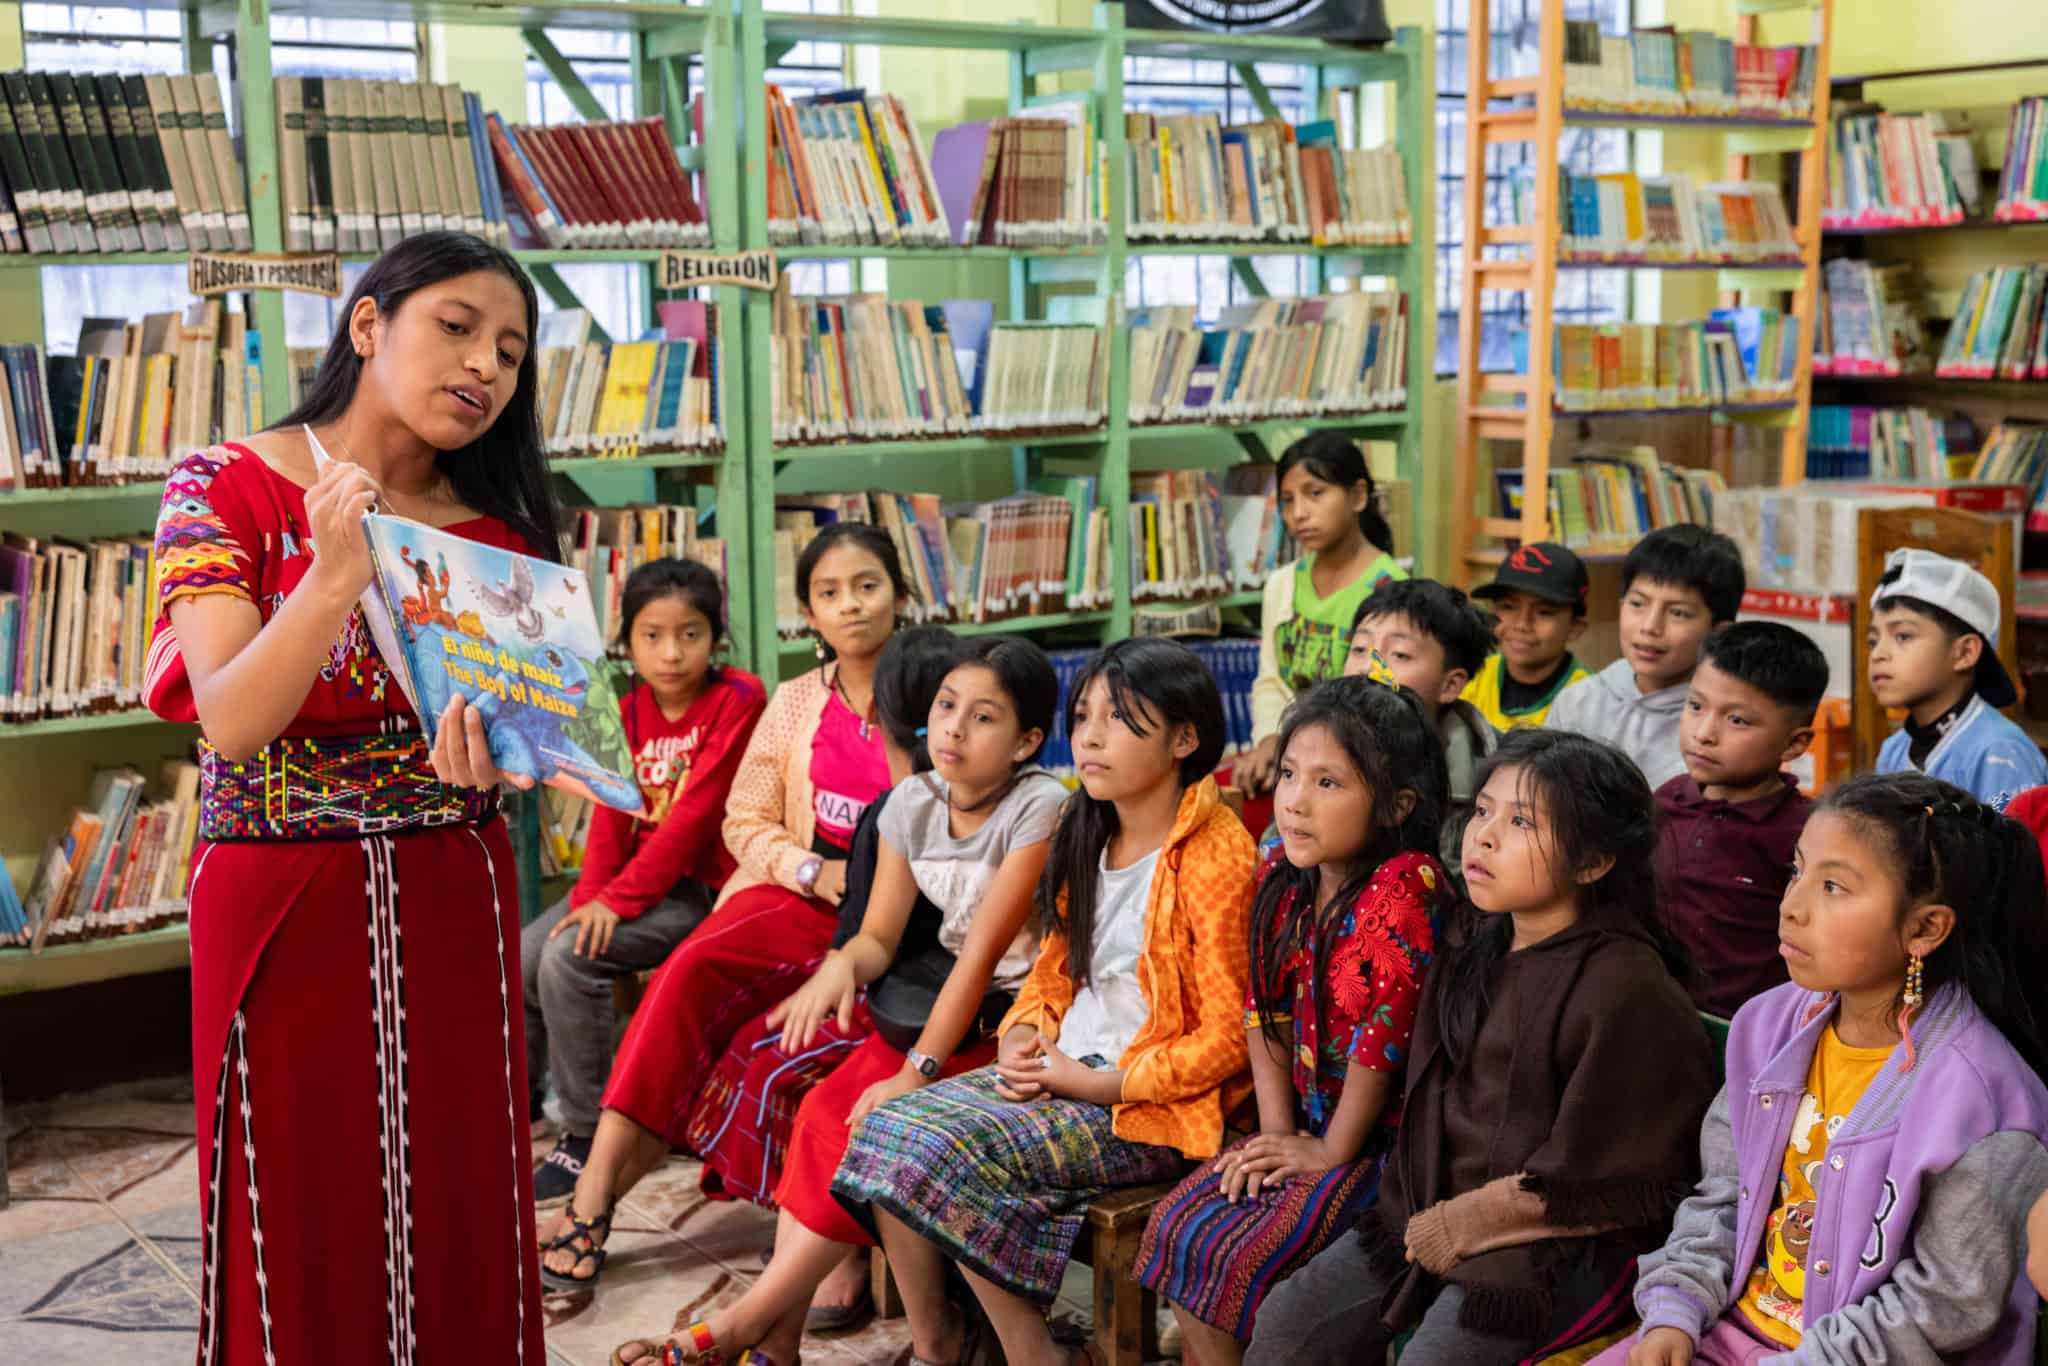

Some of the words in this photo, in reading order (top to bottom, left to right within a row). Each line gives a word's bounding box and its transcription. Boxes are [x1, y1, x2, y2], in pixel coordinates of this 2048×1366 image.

[258, 264, 266, 283] Y
[667, 253, 771, 285] RELIGION
[442, 636, 459, 656] El
[461, 640, 496, 667] niño
[498, 650, 519, 673] de
[443, 660, 474, 687] The
[474, 668, 507, 701] Boy
[510, 681, 528, 704] of
[528, 685, 578, 718] Maize
